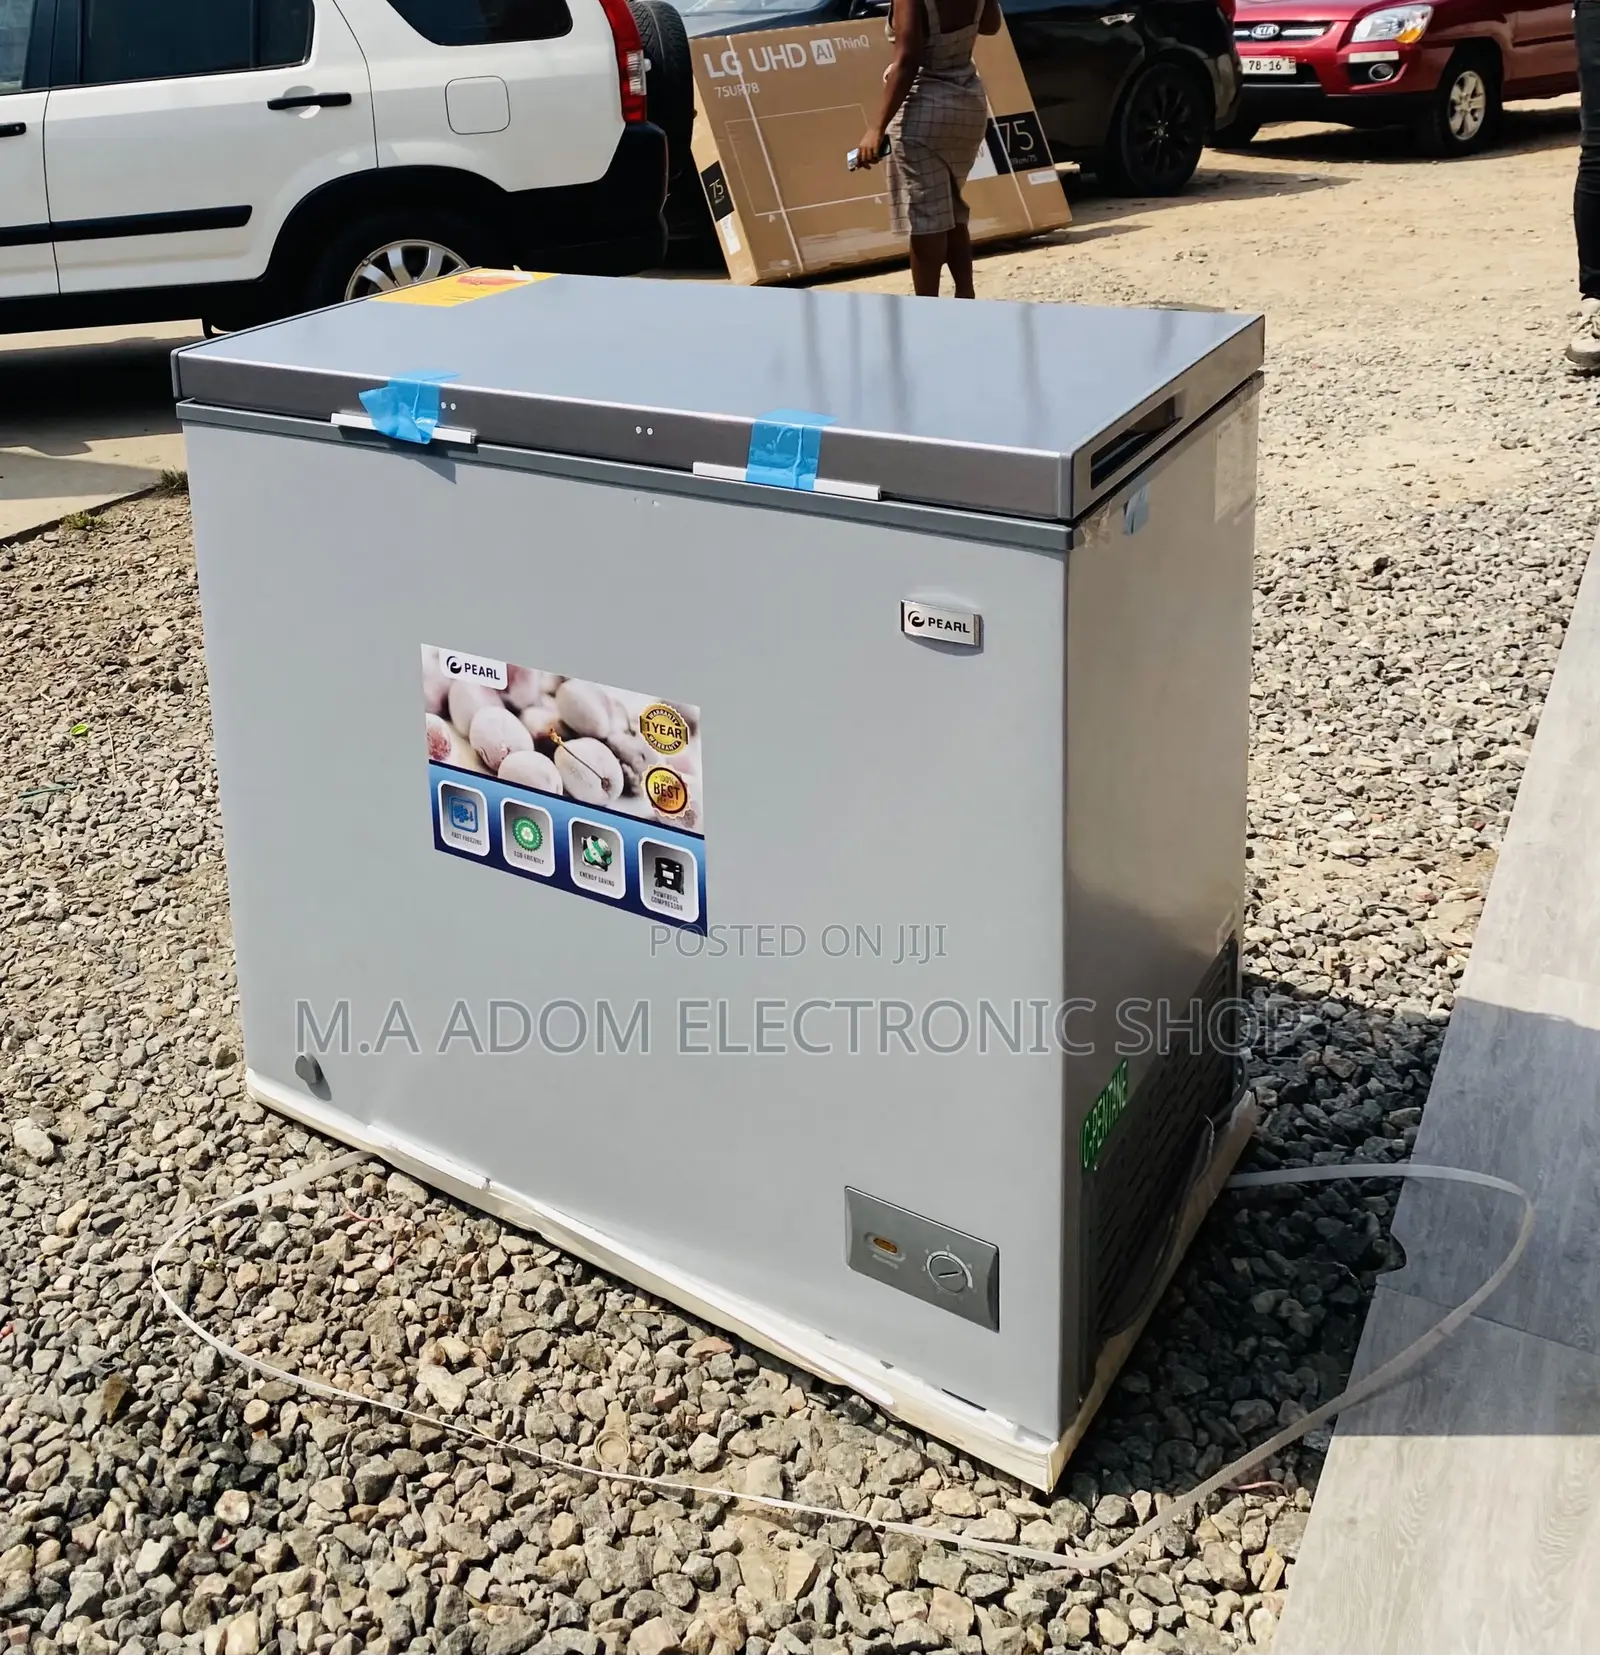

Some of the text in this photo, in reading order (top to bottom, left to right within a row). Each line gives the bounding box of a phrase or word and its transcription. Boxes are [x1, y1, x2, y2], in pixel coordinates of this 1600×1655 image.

[1254, 25, 1275, 36] KIA
[703, 50, 743, 79] LG
[748, 43, 808, 72] UHD
[833, 34, 870, 51] ThinQ
[1248, 60, 1282, 71] 78-16
[992, 119, 1034, 153] 75
[709, 178, 724, 199] 75
[928, 617, 970, 634] PEARL
[464, 662, 501, 681] PEARL
[648, 709, 681, 726] WARRANTY
[652, 722, 683, 739] YEAR
[648, 734, 681, 751] WARRANTY
[653, 781, 681, 800] BEST
